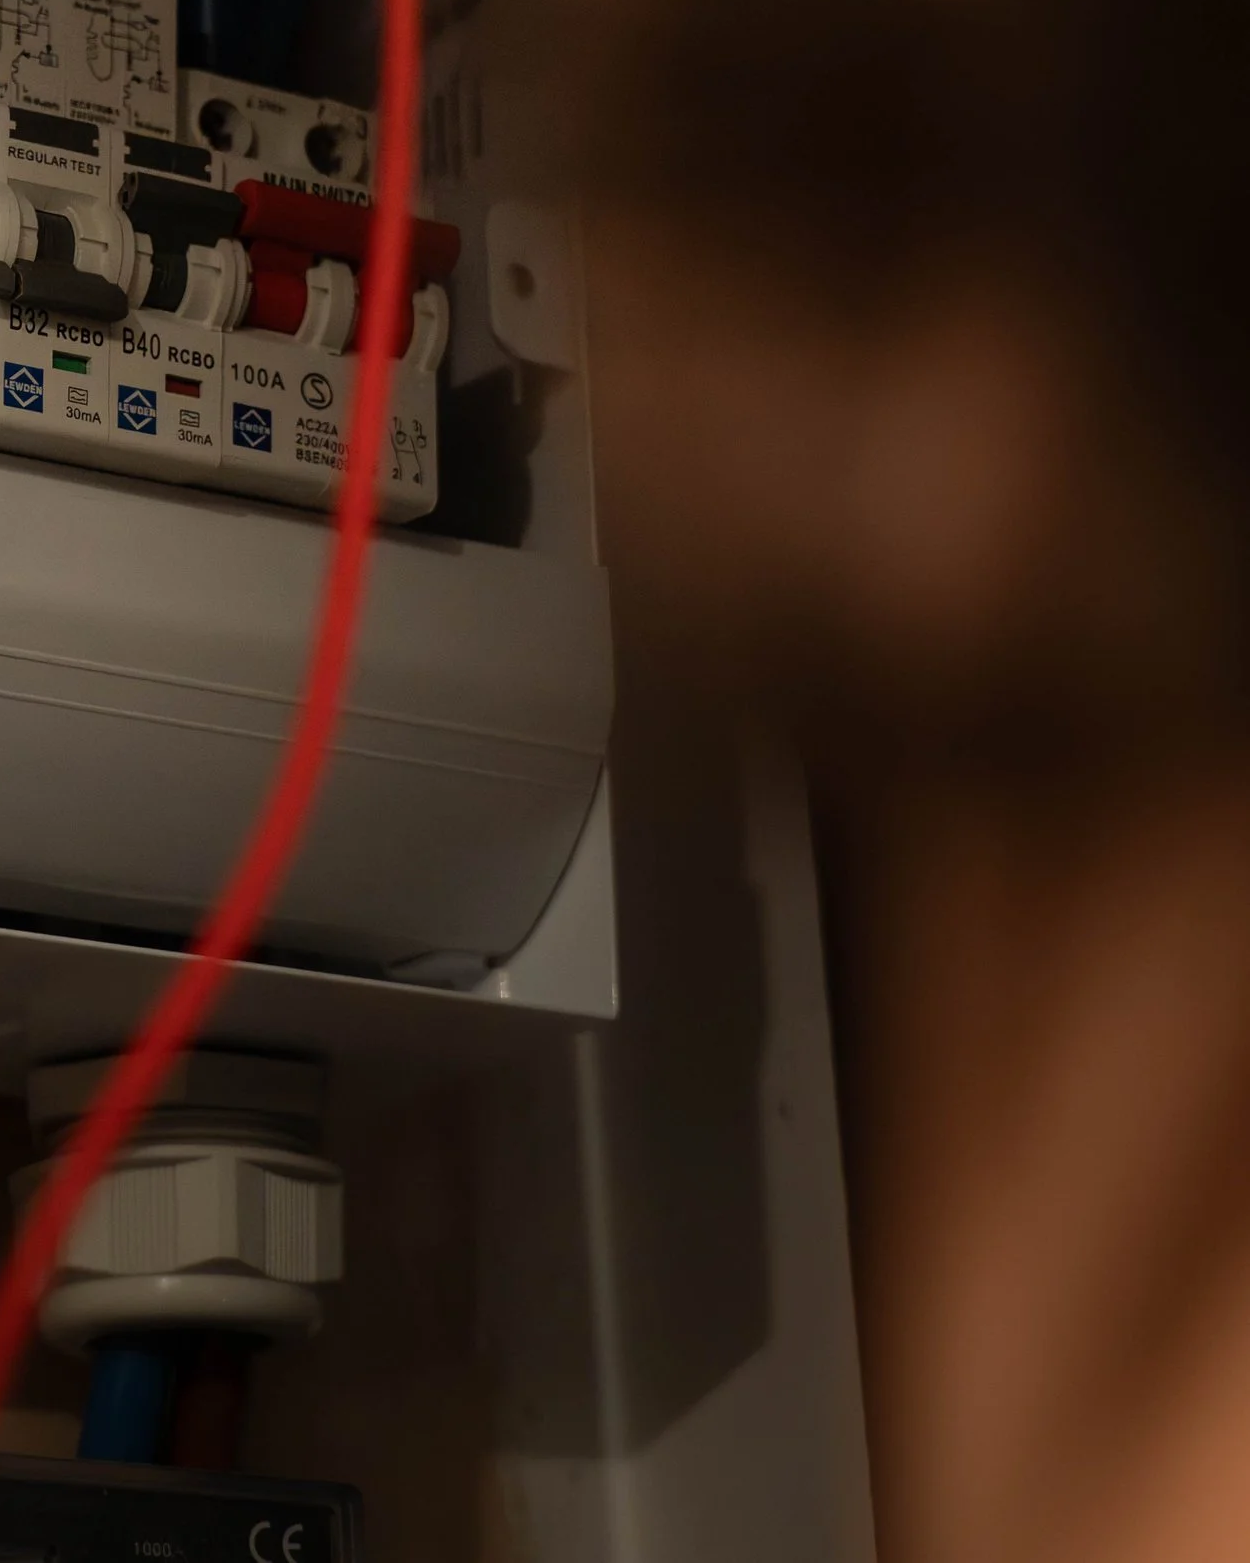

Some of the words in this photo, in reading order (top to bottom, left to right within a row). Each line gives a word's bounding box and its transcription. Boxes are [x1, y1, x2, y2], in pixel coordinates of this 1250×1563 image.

[8, 147, 67, 169] REGULAR
[70, 160, 101, 176] TEST
[10, 303, 48, 336] B32
[56, 323, 104, 347] RCBO
[122, 327, 161, 360] B40
[168, 346, 215, 370] RCBO
[231, 363, 285, 391] 100A
[4, 379, 43, 395] LEWDEN
[66, 407, 101, 424] 30mA
[118, 402, 157, 418] LEWDEN
[233, 418, 272, 437] LEWDEN
[178, 428, 213, 447] 30mA
